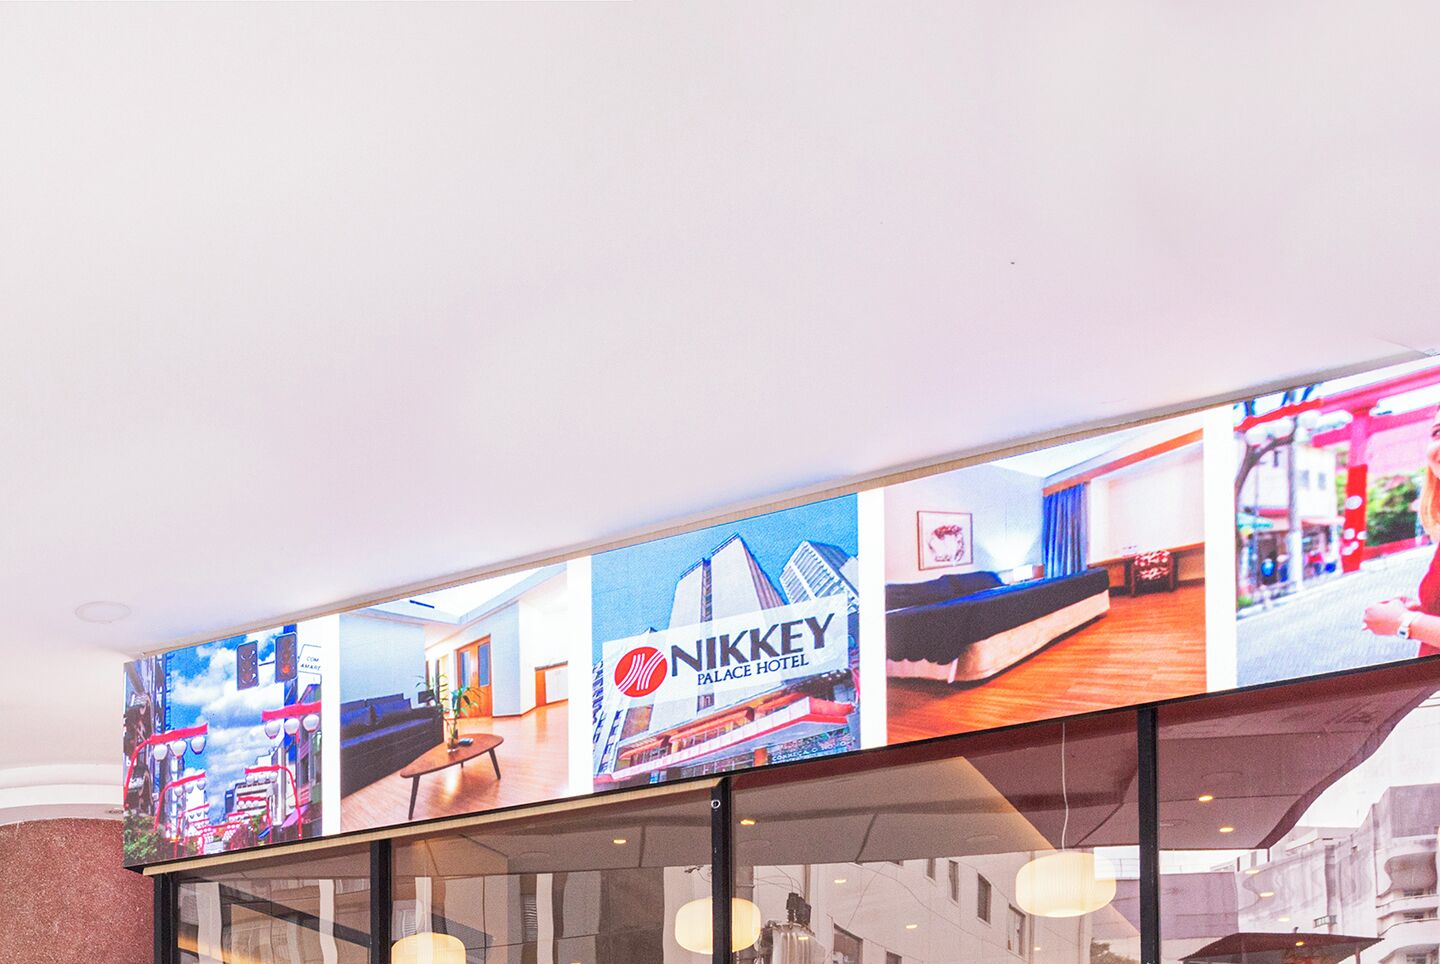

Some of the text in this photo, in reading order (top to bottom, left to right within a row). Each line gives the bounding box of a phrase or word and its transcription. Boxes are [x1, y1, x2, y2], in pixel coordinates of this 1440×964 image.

[671, 613, 835, 677] NIKKEY
[697, 653, 810, 686] PALACE HOTEL
